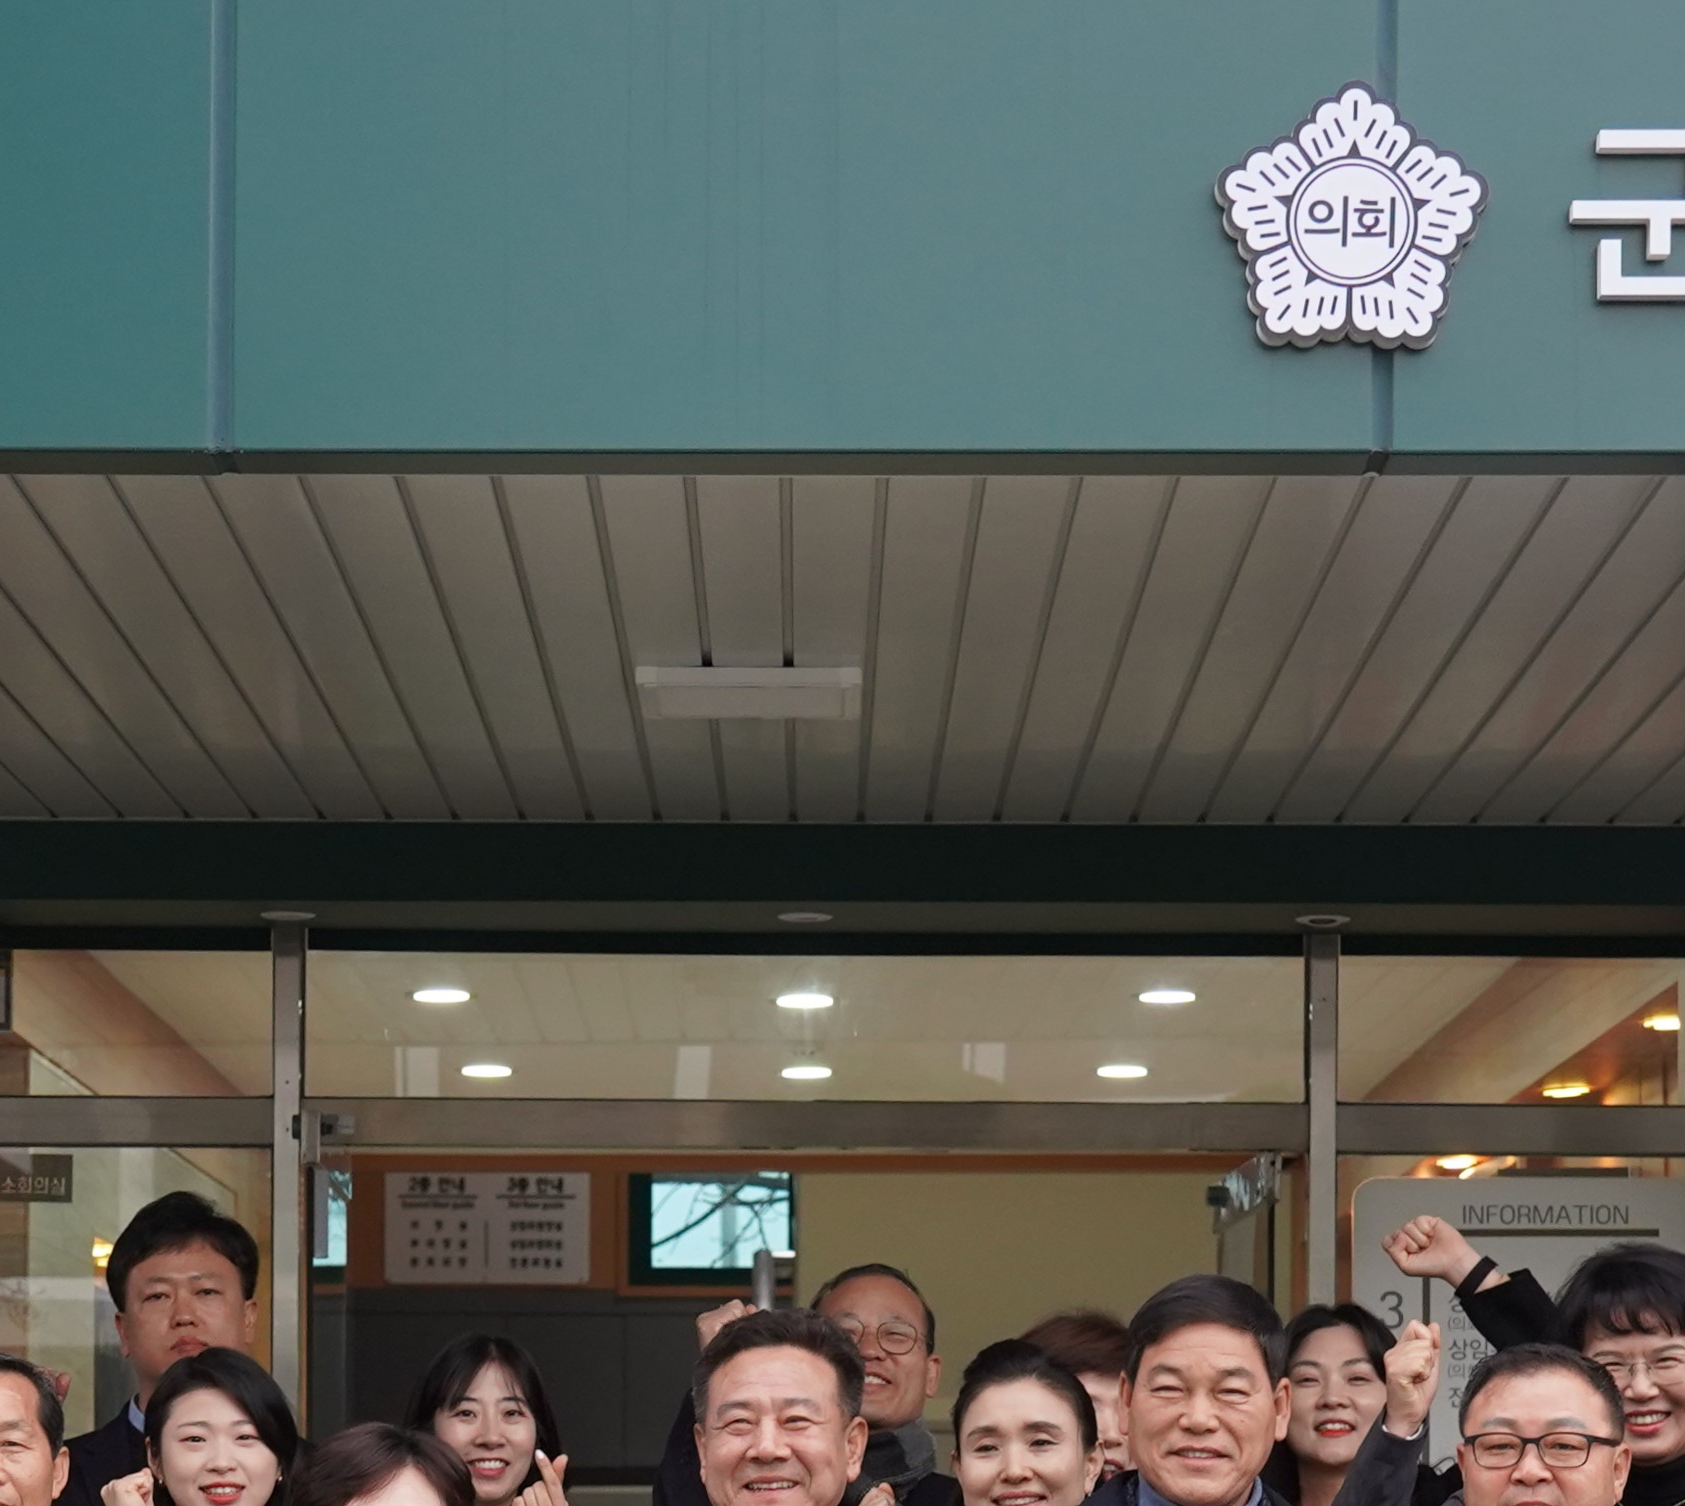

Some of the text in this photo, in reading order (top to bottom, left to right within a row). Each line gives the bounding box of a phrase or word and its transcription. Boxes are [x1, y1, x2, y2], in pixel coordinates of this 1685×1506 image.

[1304, 195, 1396, 249] 의회
[1, 1176, 65, 1195] 소회의실
[1462, 1204, 1630, 1226] INFORMATION
[1380, 1291, 1404, 1329] 3
